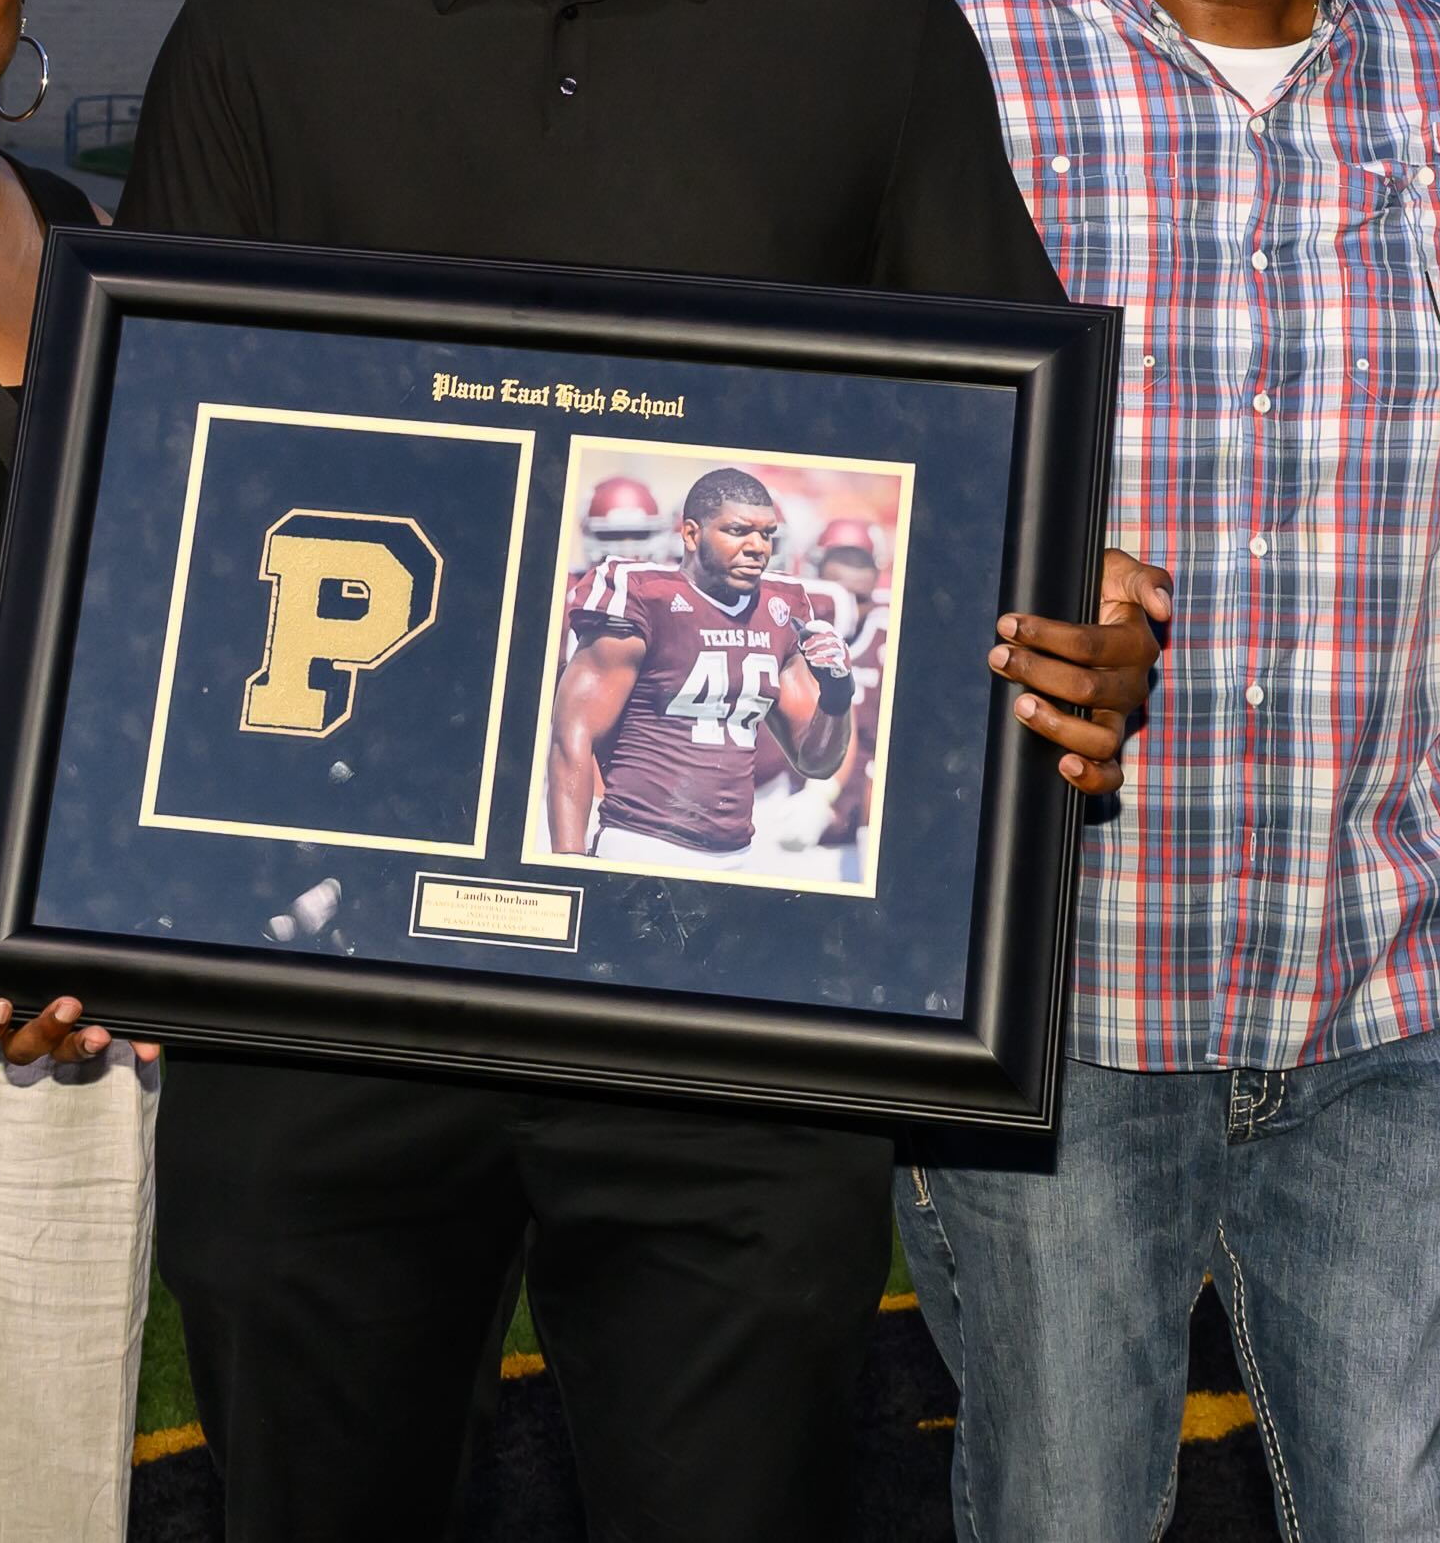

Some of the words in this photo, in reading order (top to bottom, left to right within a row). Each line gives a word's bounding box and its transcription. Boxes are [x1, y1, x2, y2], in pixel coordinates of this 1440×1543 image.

[432, 372, 495, 402] Plano
[500, 378, 550, 407] East
[555, 383, 606, 415] High
[609, 388, 685, 420] School
[239, 508, 444, 739] P
[699, 629, 745, 647] TEXAS
[665, 651, 780, 749] 46
[456, 890, 491, 902] Landis
[495, 894, 538, 906] Durham
